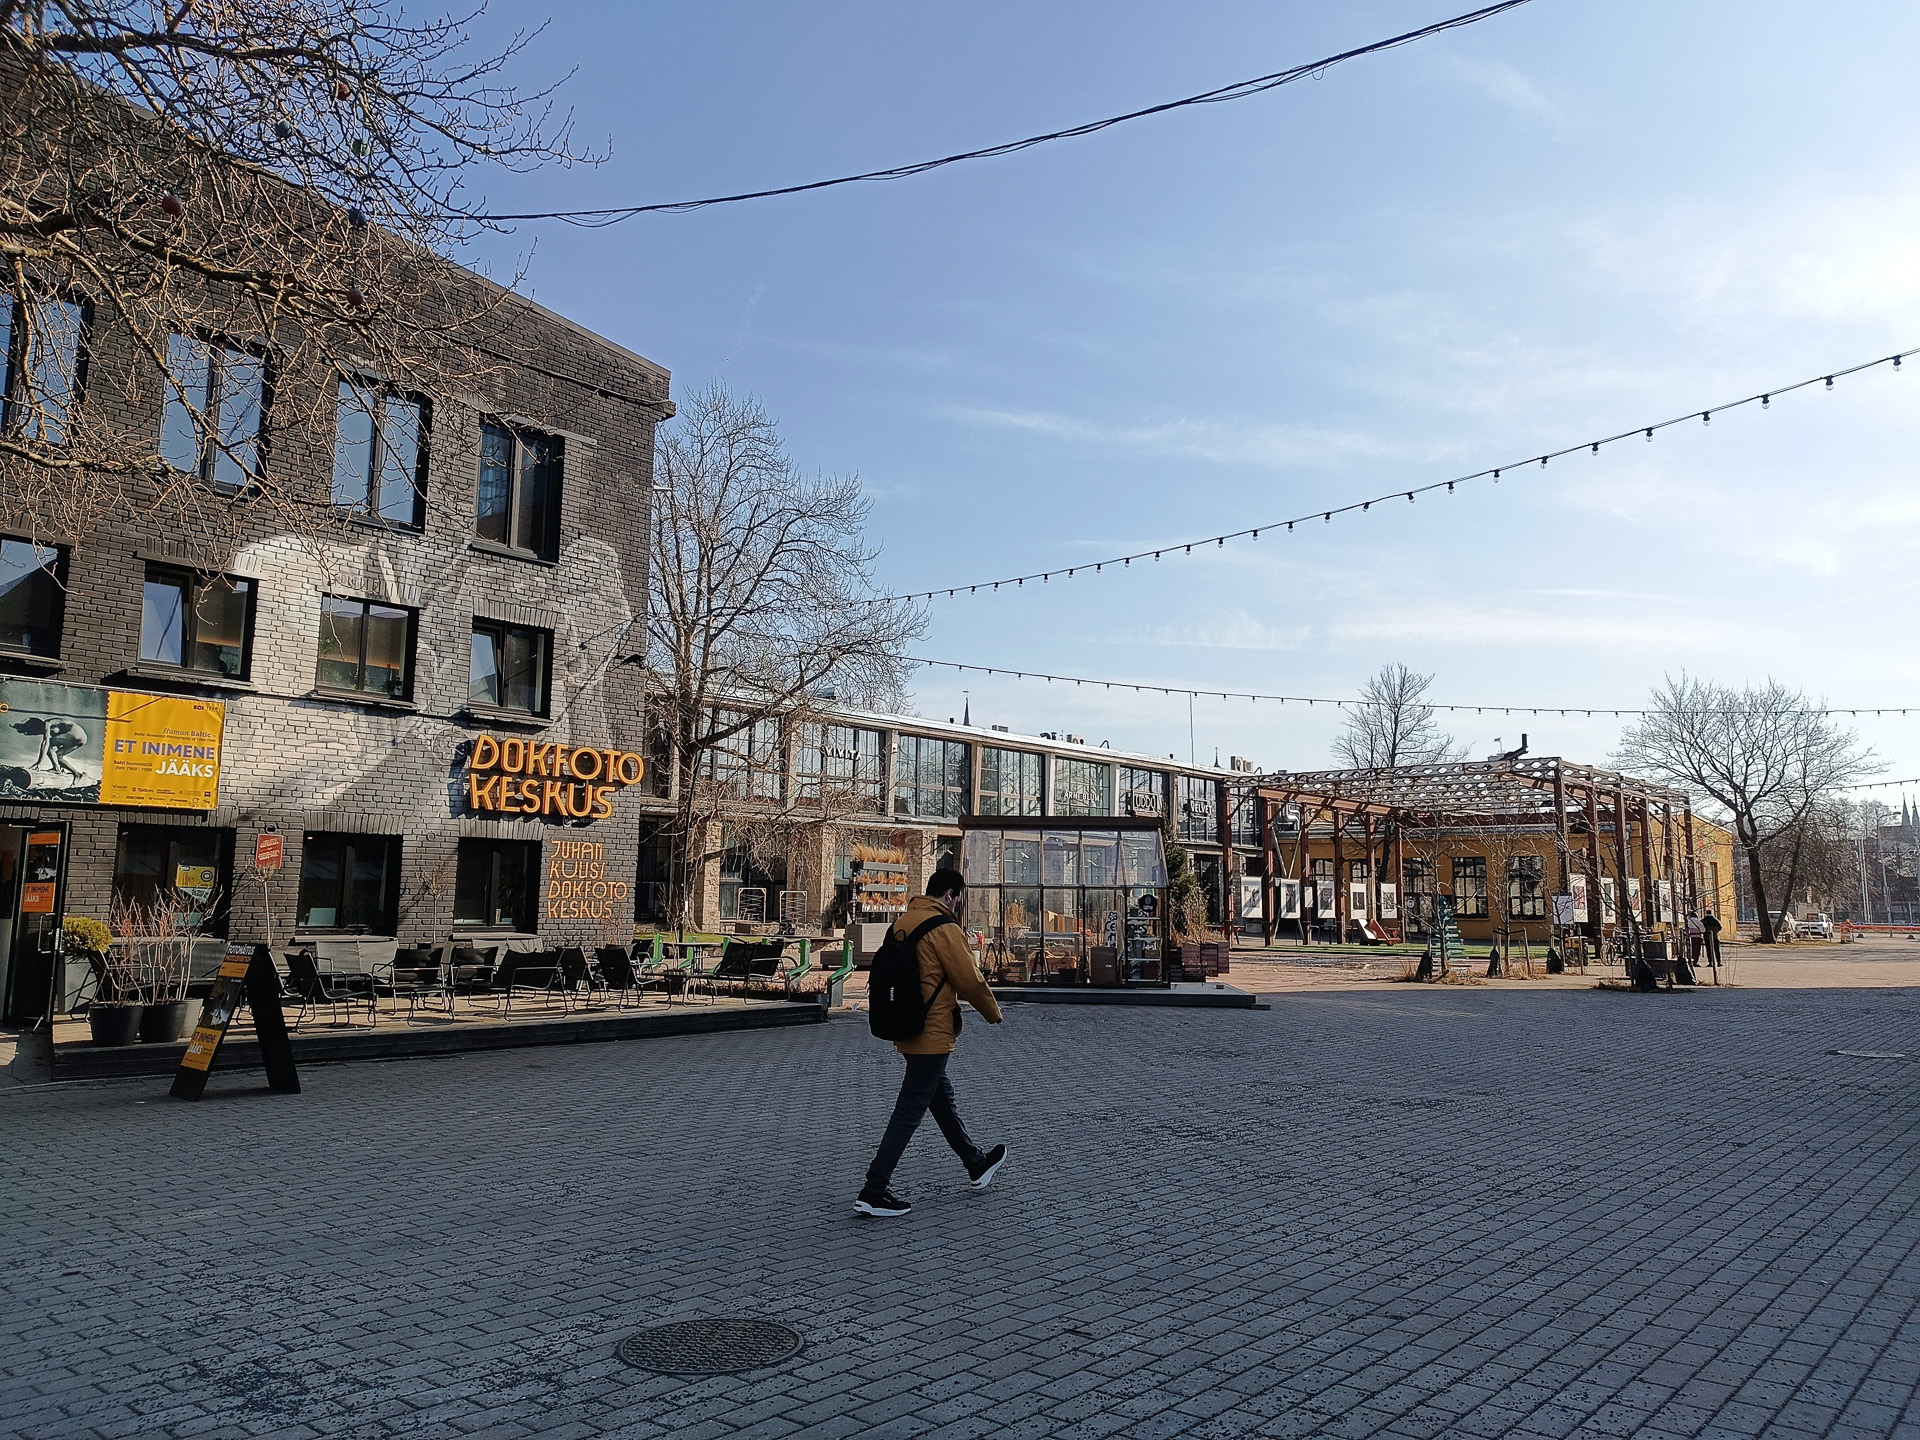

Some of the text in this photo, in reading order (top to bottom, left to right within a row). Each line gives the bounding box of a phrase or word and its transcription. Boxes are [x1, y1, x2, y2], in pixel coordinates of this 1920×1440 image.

[163, 728, 189, 736] Human
[114, 738, 216, 760] ET INIMENE
[825, 745, 863, 760] VIVITA
[155, 758, 214, 778] JÄÄKS
[470, 734, 645, 785] DOKFOTO
[469, 773, 616, 819] KESKUS
[1190, 800, 1213, 814] VELVET
[551, 840, 603, 860] JUHAN
[548, 880, 628, 899] DOKFOTO
[547, 900, 614, 918] KESKUS
